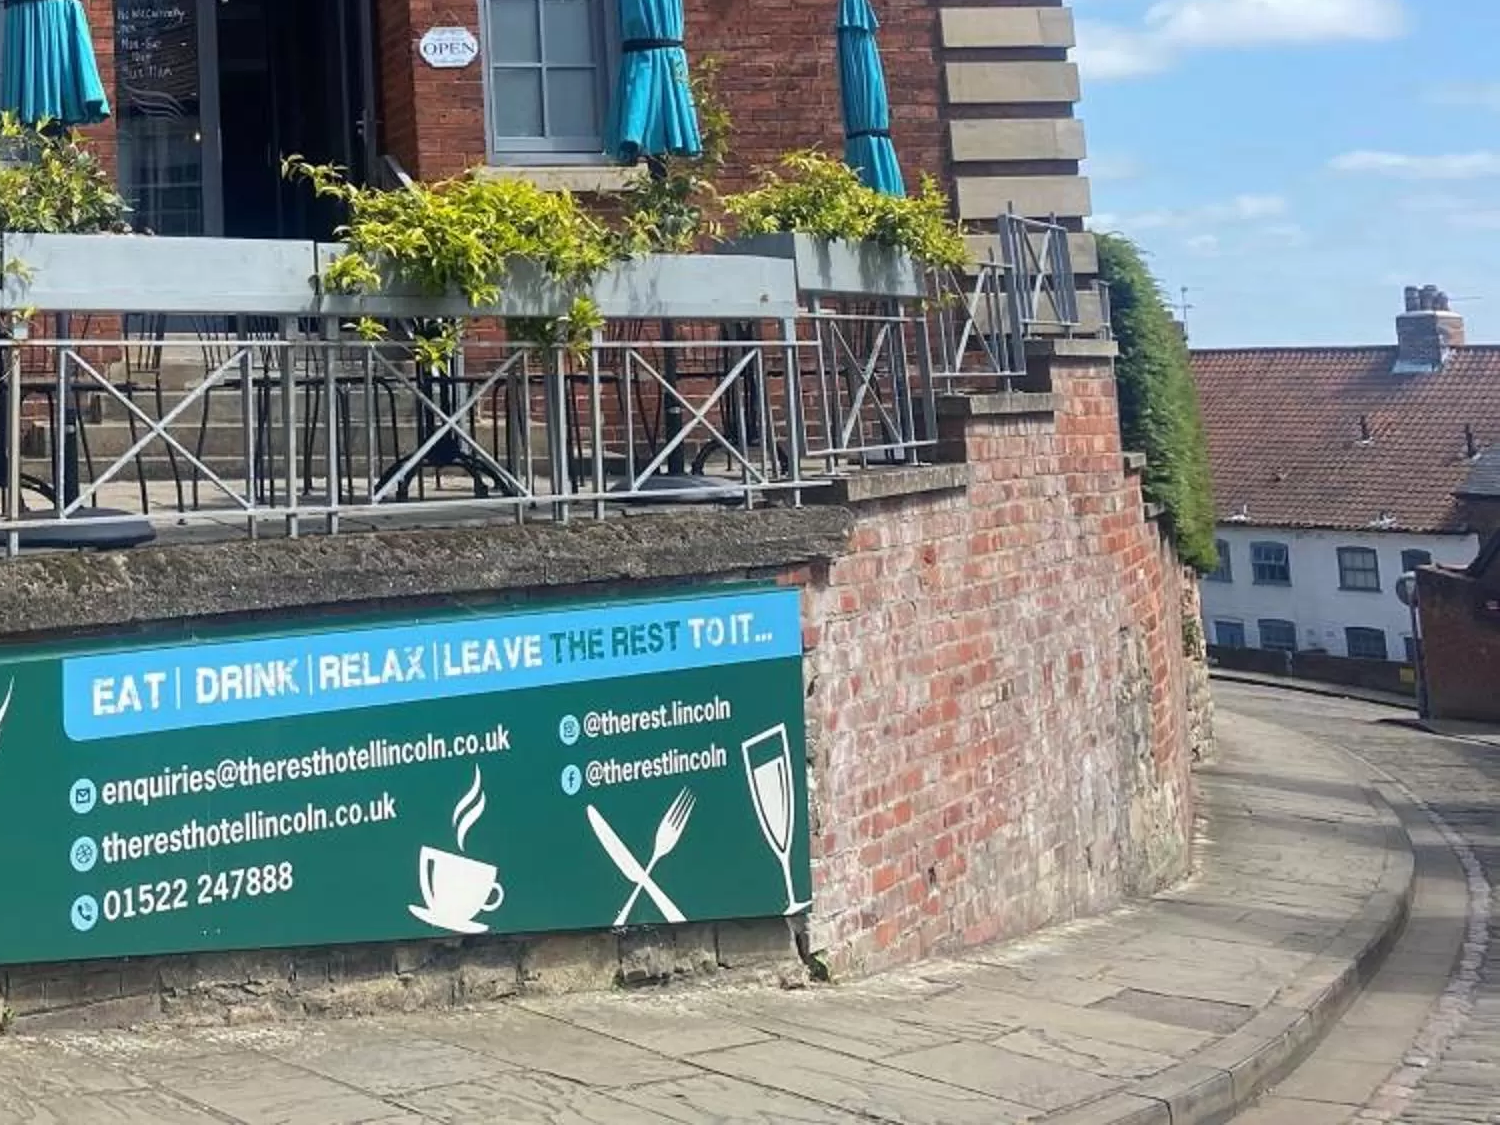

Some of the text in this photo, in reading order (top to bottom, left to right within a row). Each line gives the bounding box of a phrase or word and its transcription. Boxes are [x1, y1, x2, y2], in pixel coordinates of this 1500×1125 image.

[423, 42, 475, 55] OPEN
[92, 672, 167, 716] EAT
[196, 658, 300, 704] DRINK
[319, 646, 426, 690] RELAX
[443, 635, 542, 676] LEAVE
[550, 629, 605, 663] THE
[611, 620, 681, 656] REST
[688, 618, 724, 648] TO
[583, 695, 731, 738] @therest.lincoln
[102, 724, 510, 805] enquiries@theresthotellincoln.co.uk
[585, 744, 727, 787] @therestlincoln
[102, 791, 396, 864] theresthotellincoln.co.uk
[103, 861, 294, 922] 01522 247888
